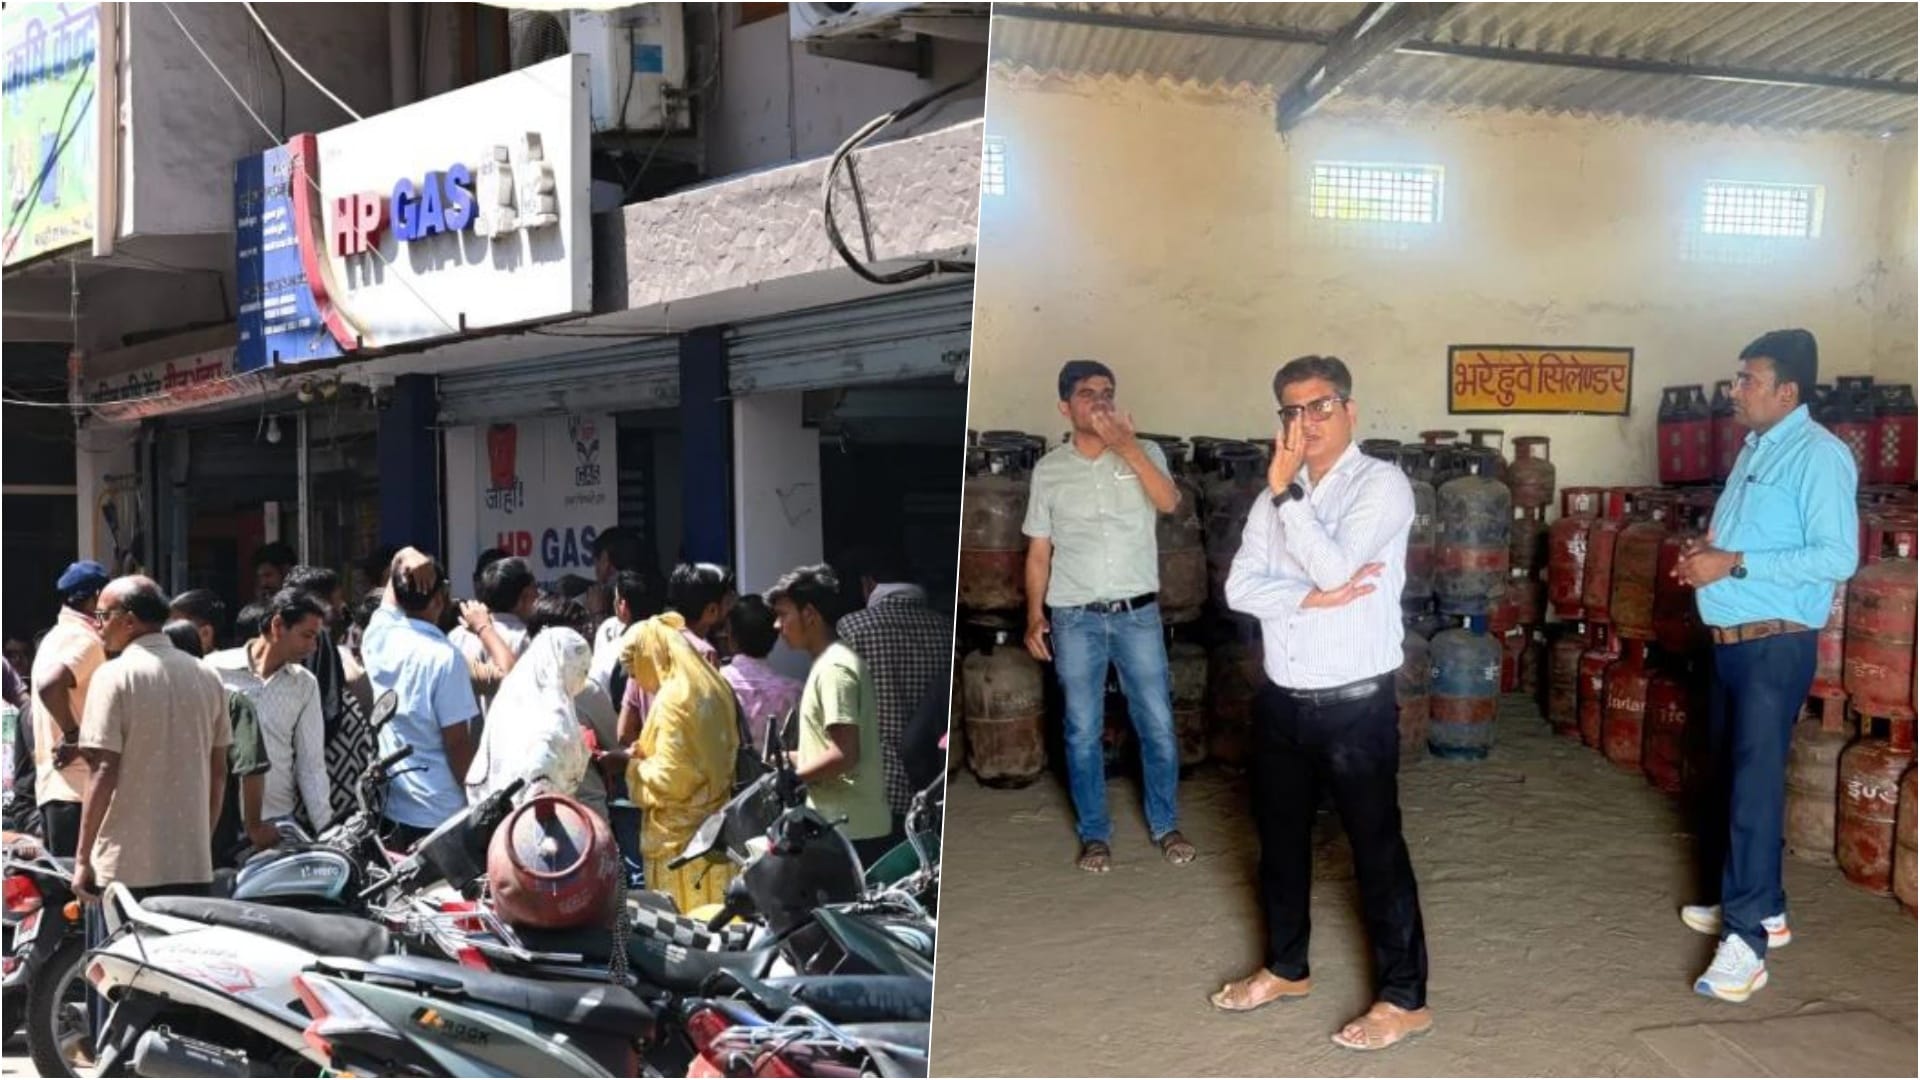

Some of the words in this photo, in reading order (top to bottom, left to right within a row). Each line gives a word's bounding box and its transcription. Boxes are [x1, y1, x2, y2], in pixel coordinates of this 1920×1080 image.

[331, 189, 383, 258] HP
[390, 161, 475, 243] GAS
[497, 529, 534, 557] HP
[541, 525, 596, 569] GAS
